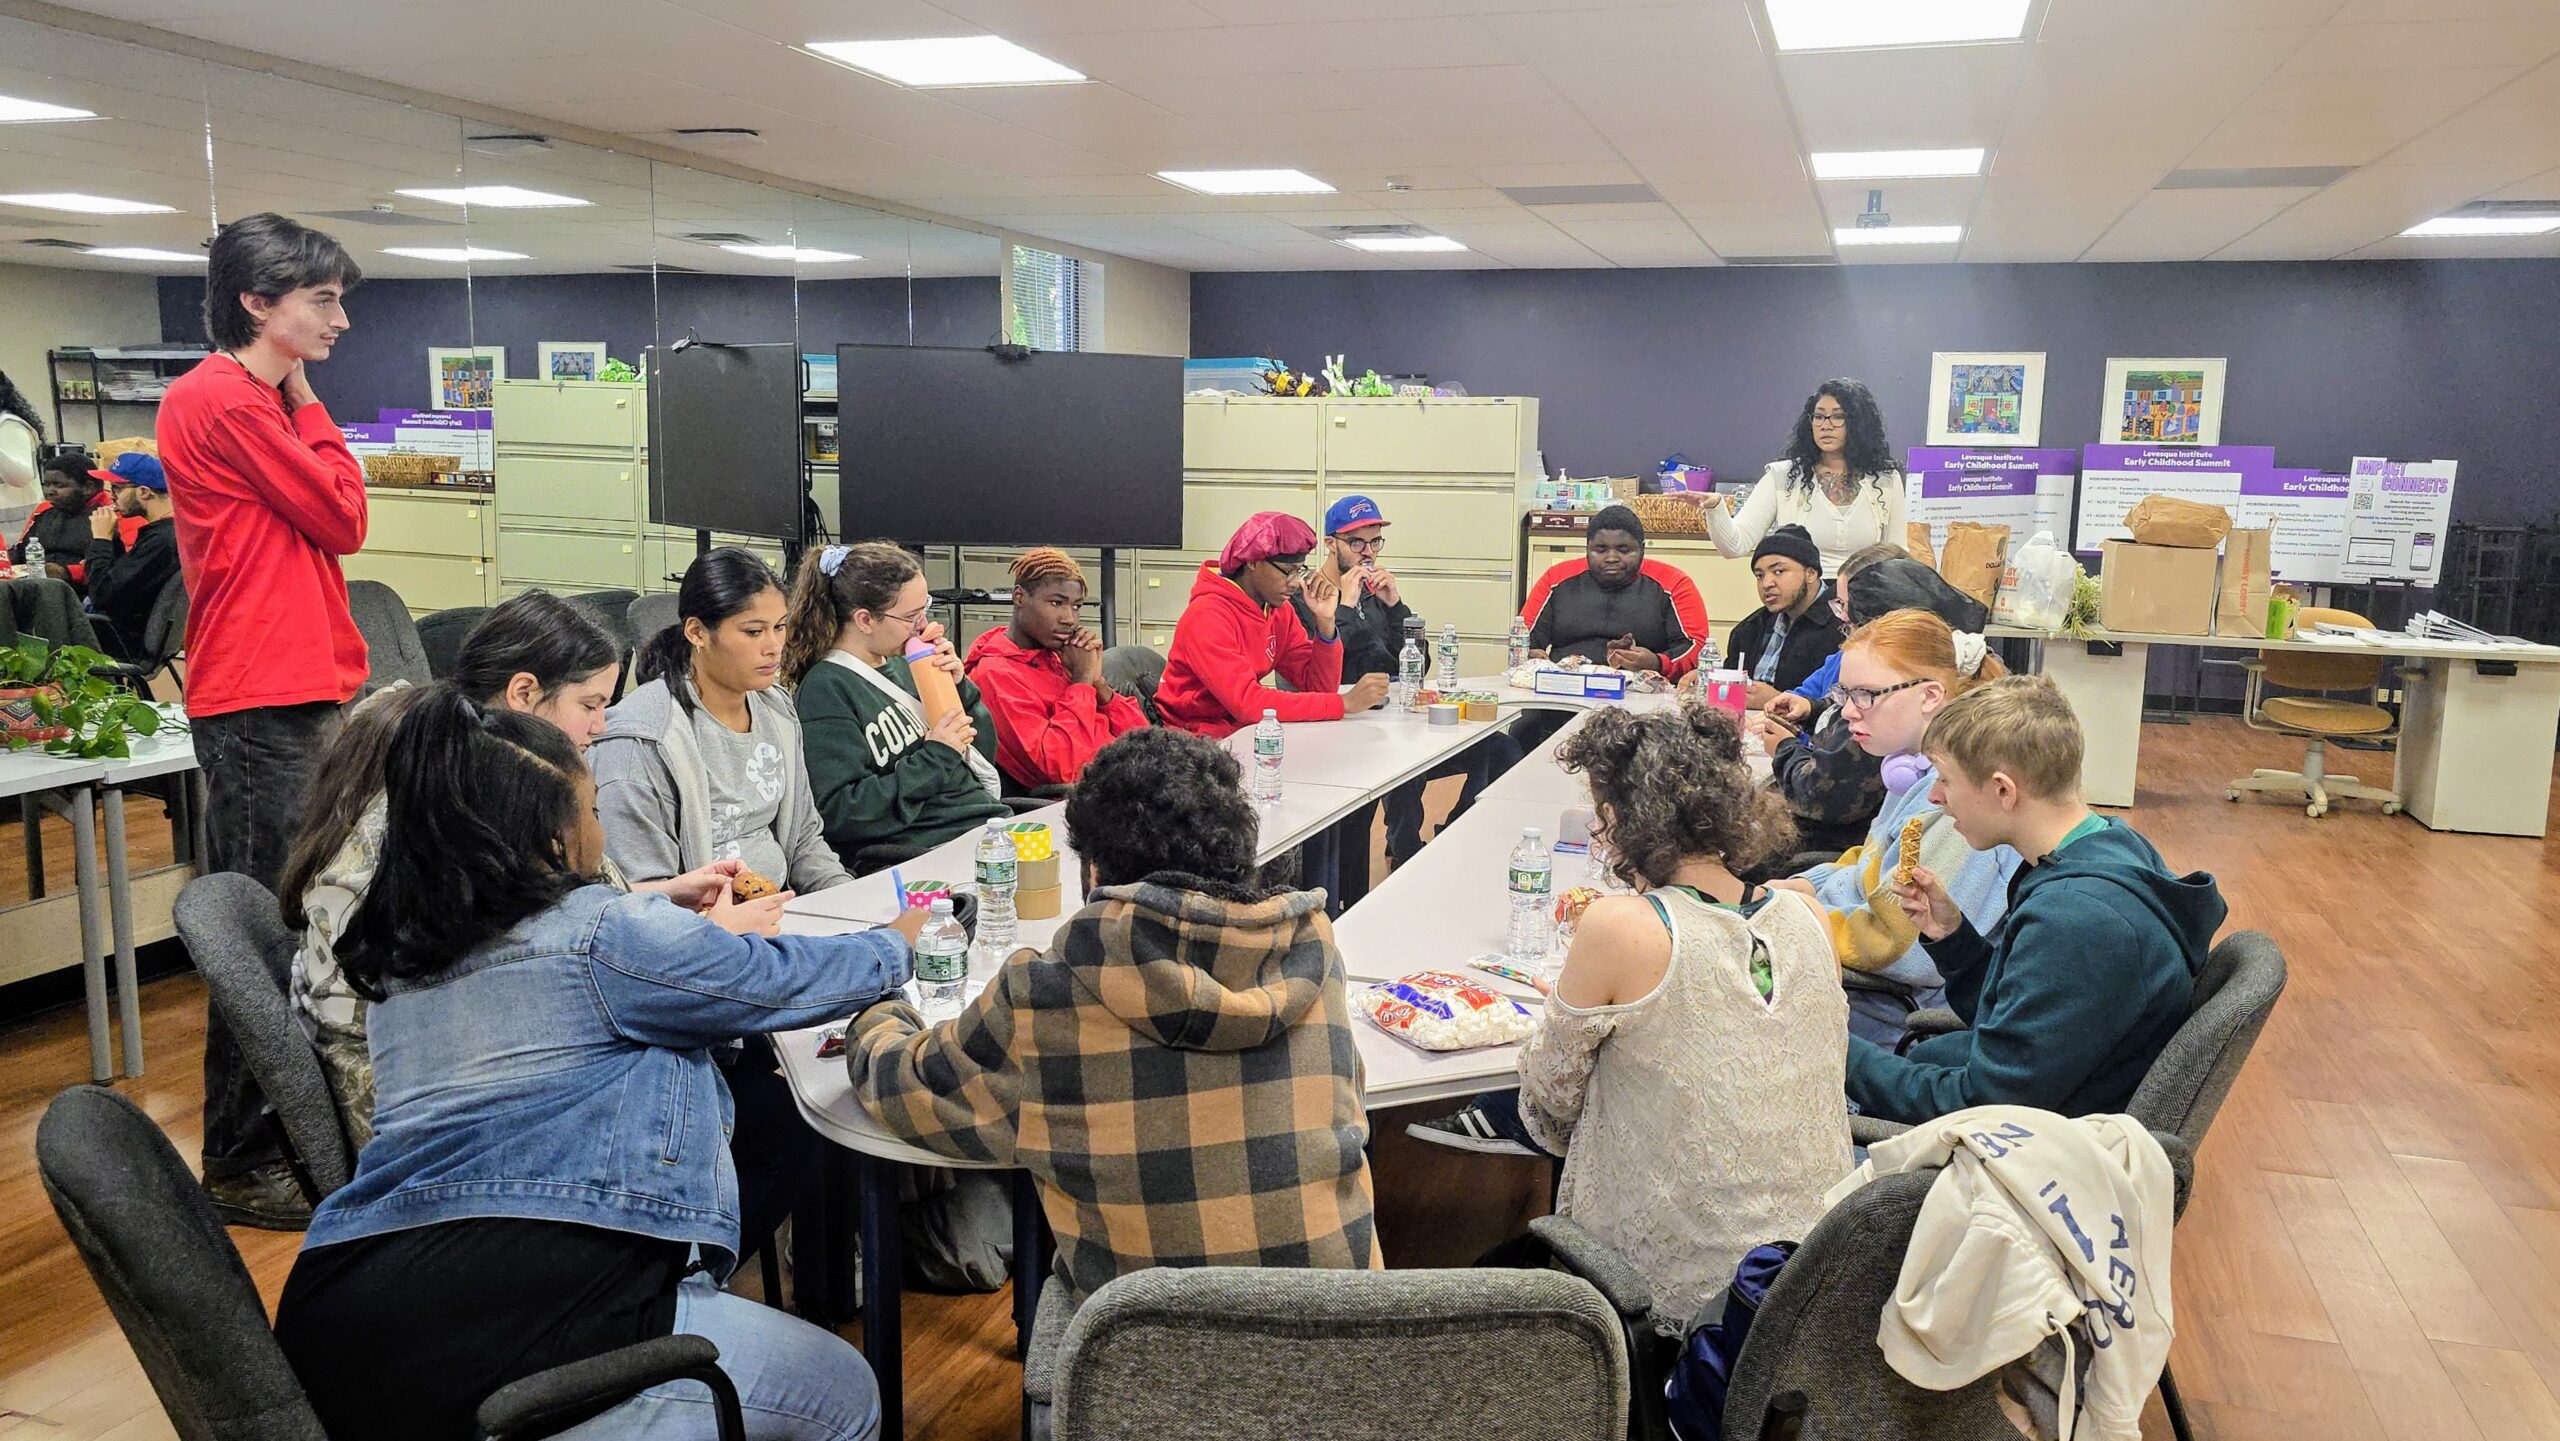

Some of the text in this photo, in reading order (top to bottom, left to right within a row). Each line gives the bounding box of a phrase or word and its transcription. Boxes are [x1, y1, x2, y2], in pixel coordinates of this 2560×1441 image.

[2143, 450, 2177, 458] Levesque
[1966, 462, 2006, 470] Childhood
[2124, 458, 2231, 467] Early Childhood Summit
[2356, 460, 2408, 476] IMPACT
[2304, 475, 2340, 483] Levesque
[1948, 484, 1962, 492] Early
[1964, 483, 1991, 492] Childhood
[2284, 483, 2308, 492] Early
[2309, 484, 2351, 492] Childhoo
[2381, 477, 2448, 494] CONNECTS
